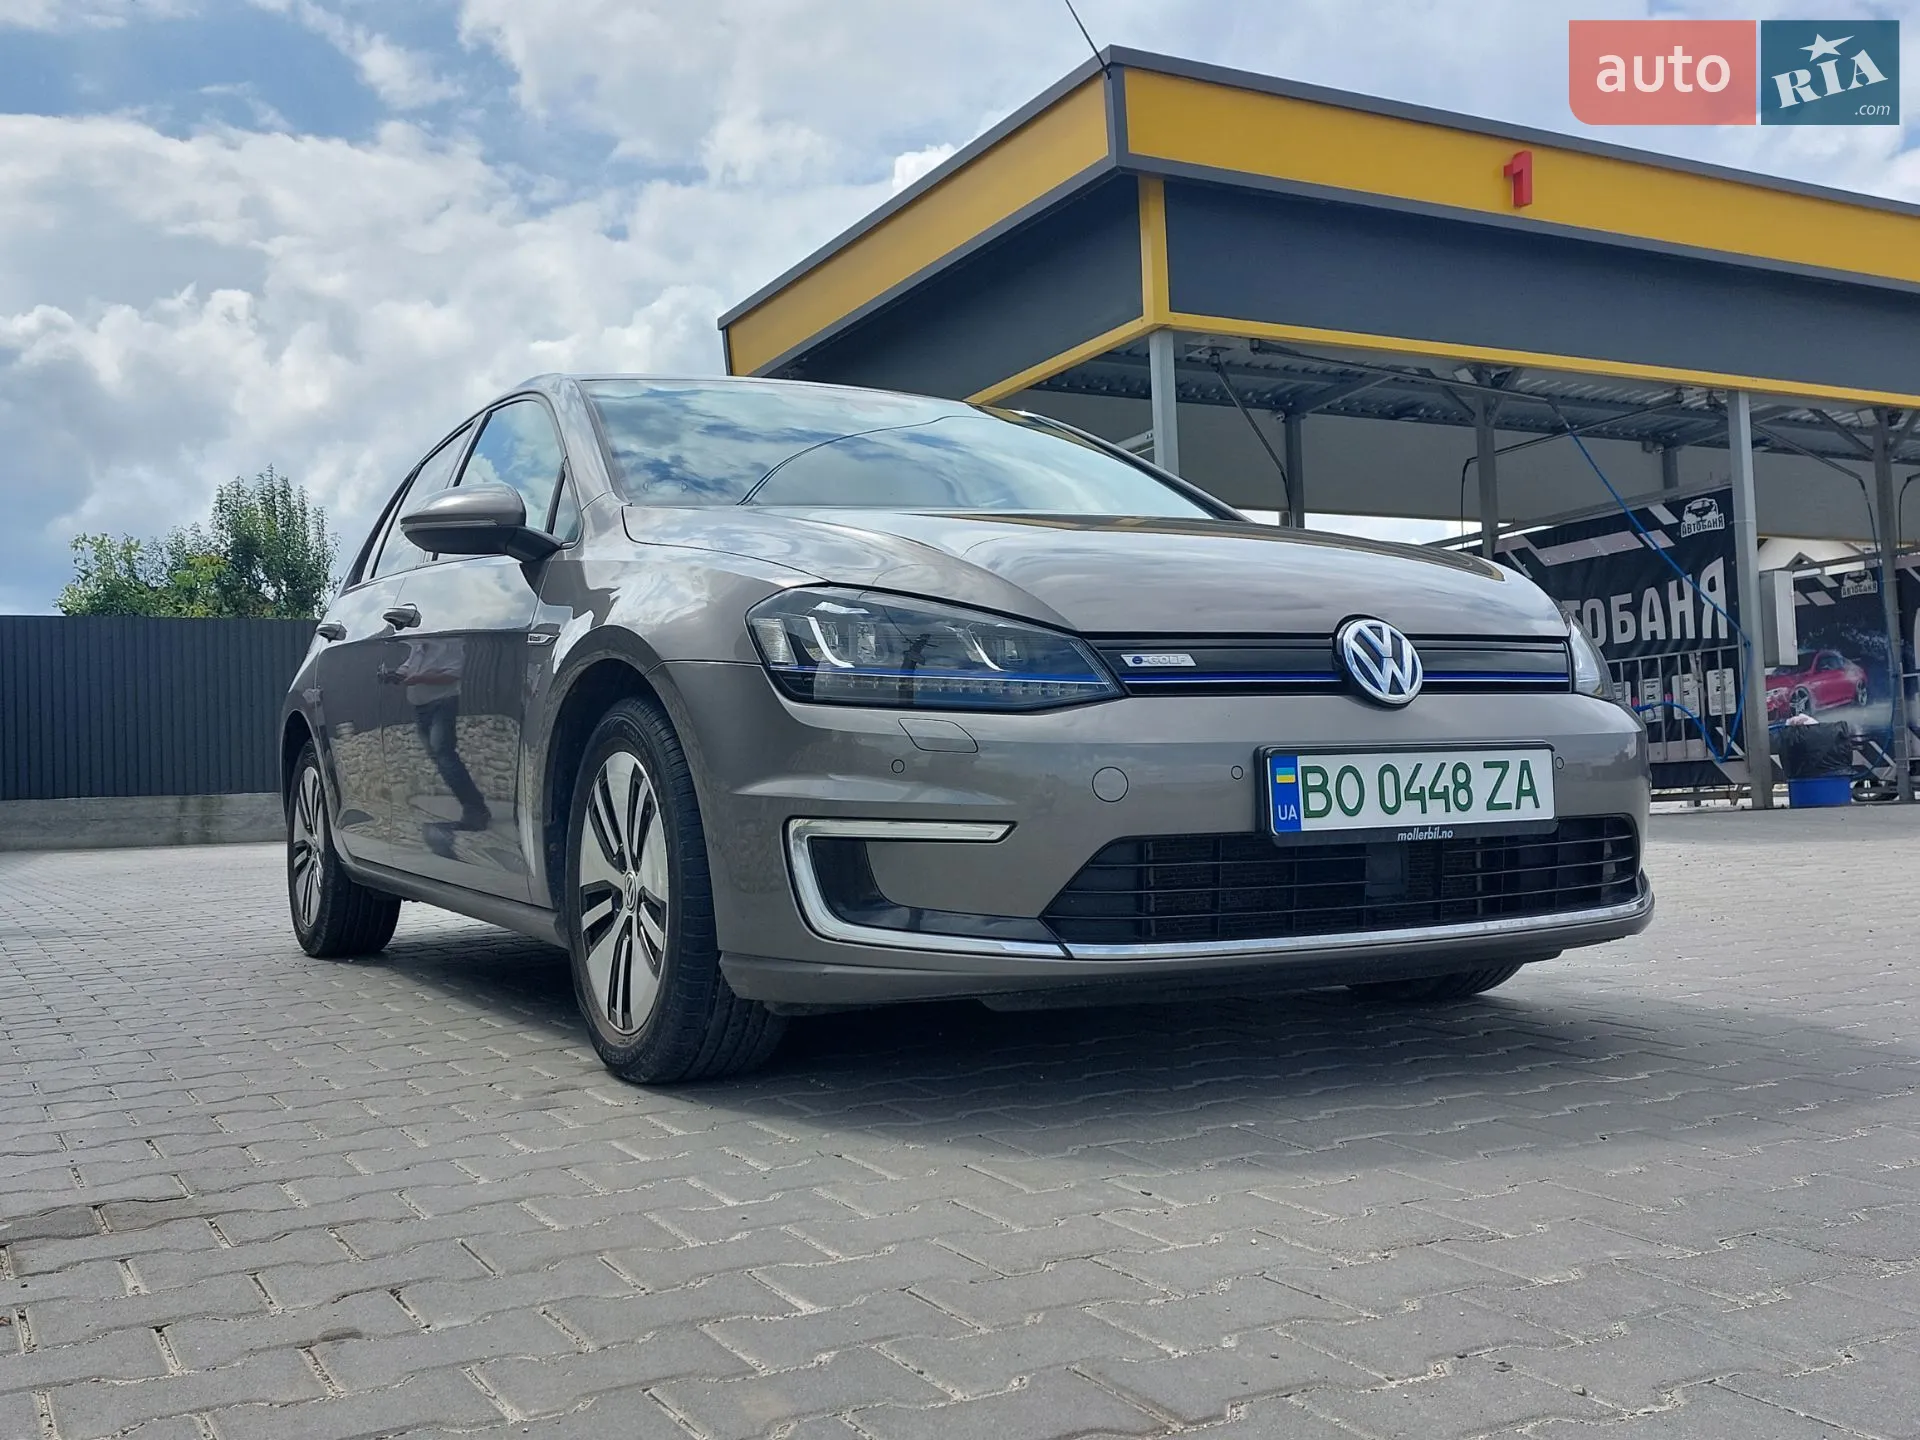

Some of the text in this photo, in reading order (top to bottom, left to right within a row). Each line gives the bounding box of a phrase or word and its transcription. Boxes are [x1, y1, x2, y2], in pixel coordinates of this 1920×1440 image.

[1503, 150, 1533, 208] 1
[1681, 513, 1725, 538] АВТОБАНЯ
[1301, 759, 1541, 818] BO 0448 ZA
[1277, 804, 1298, 821] UA
